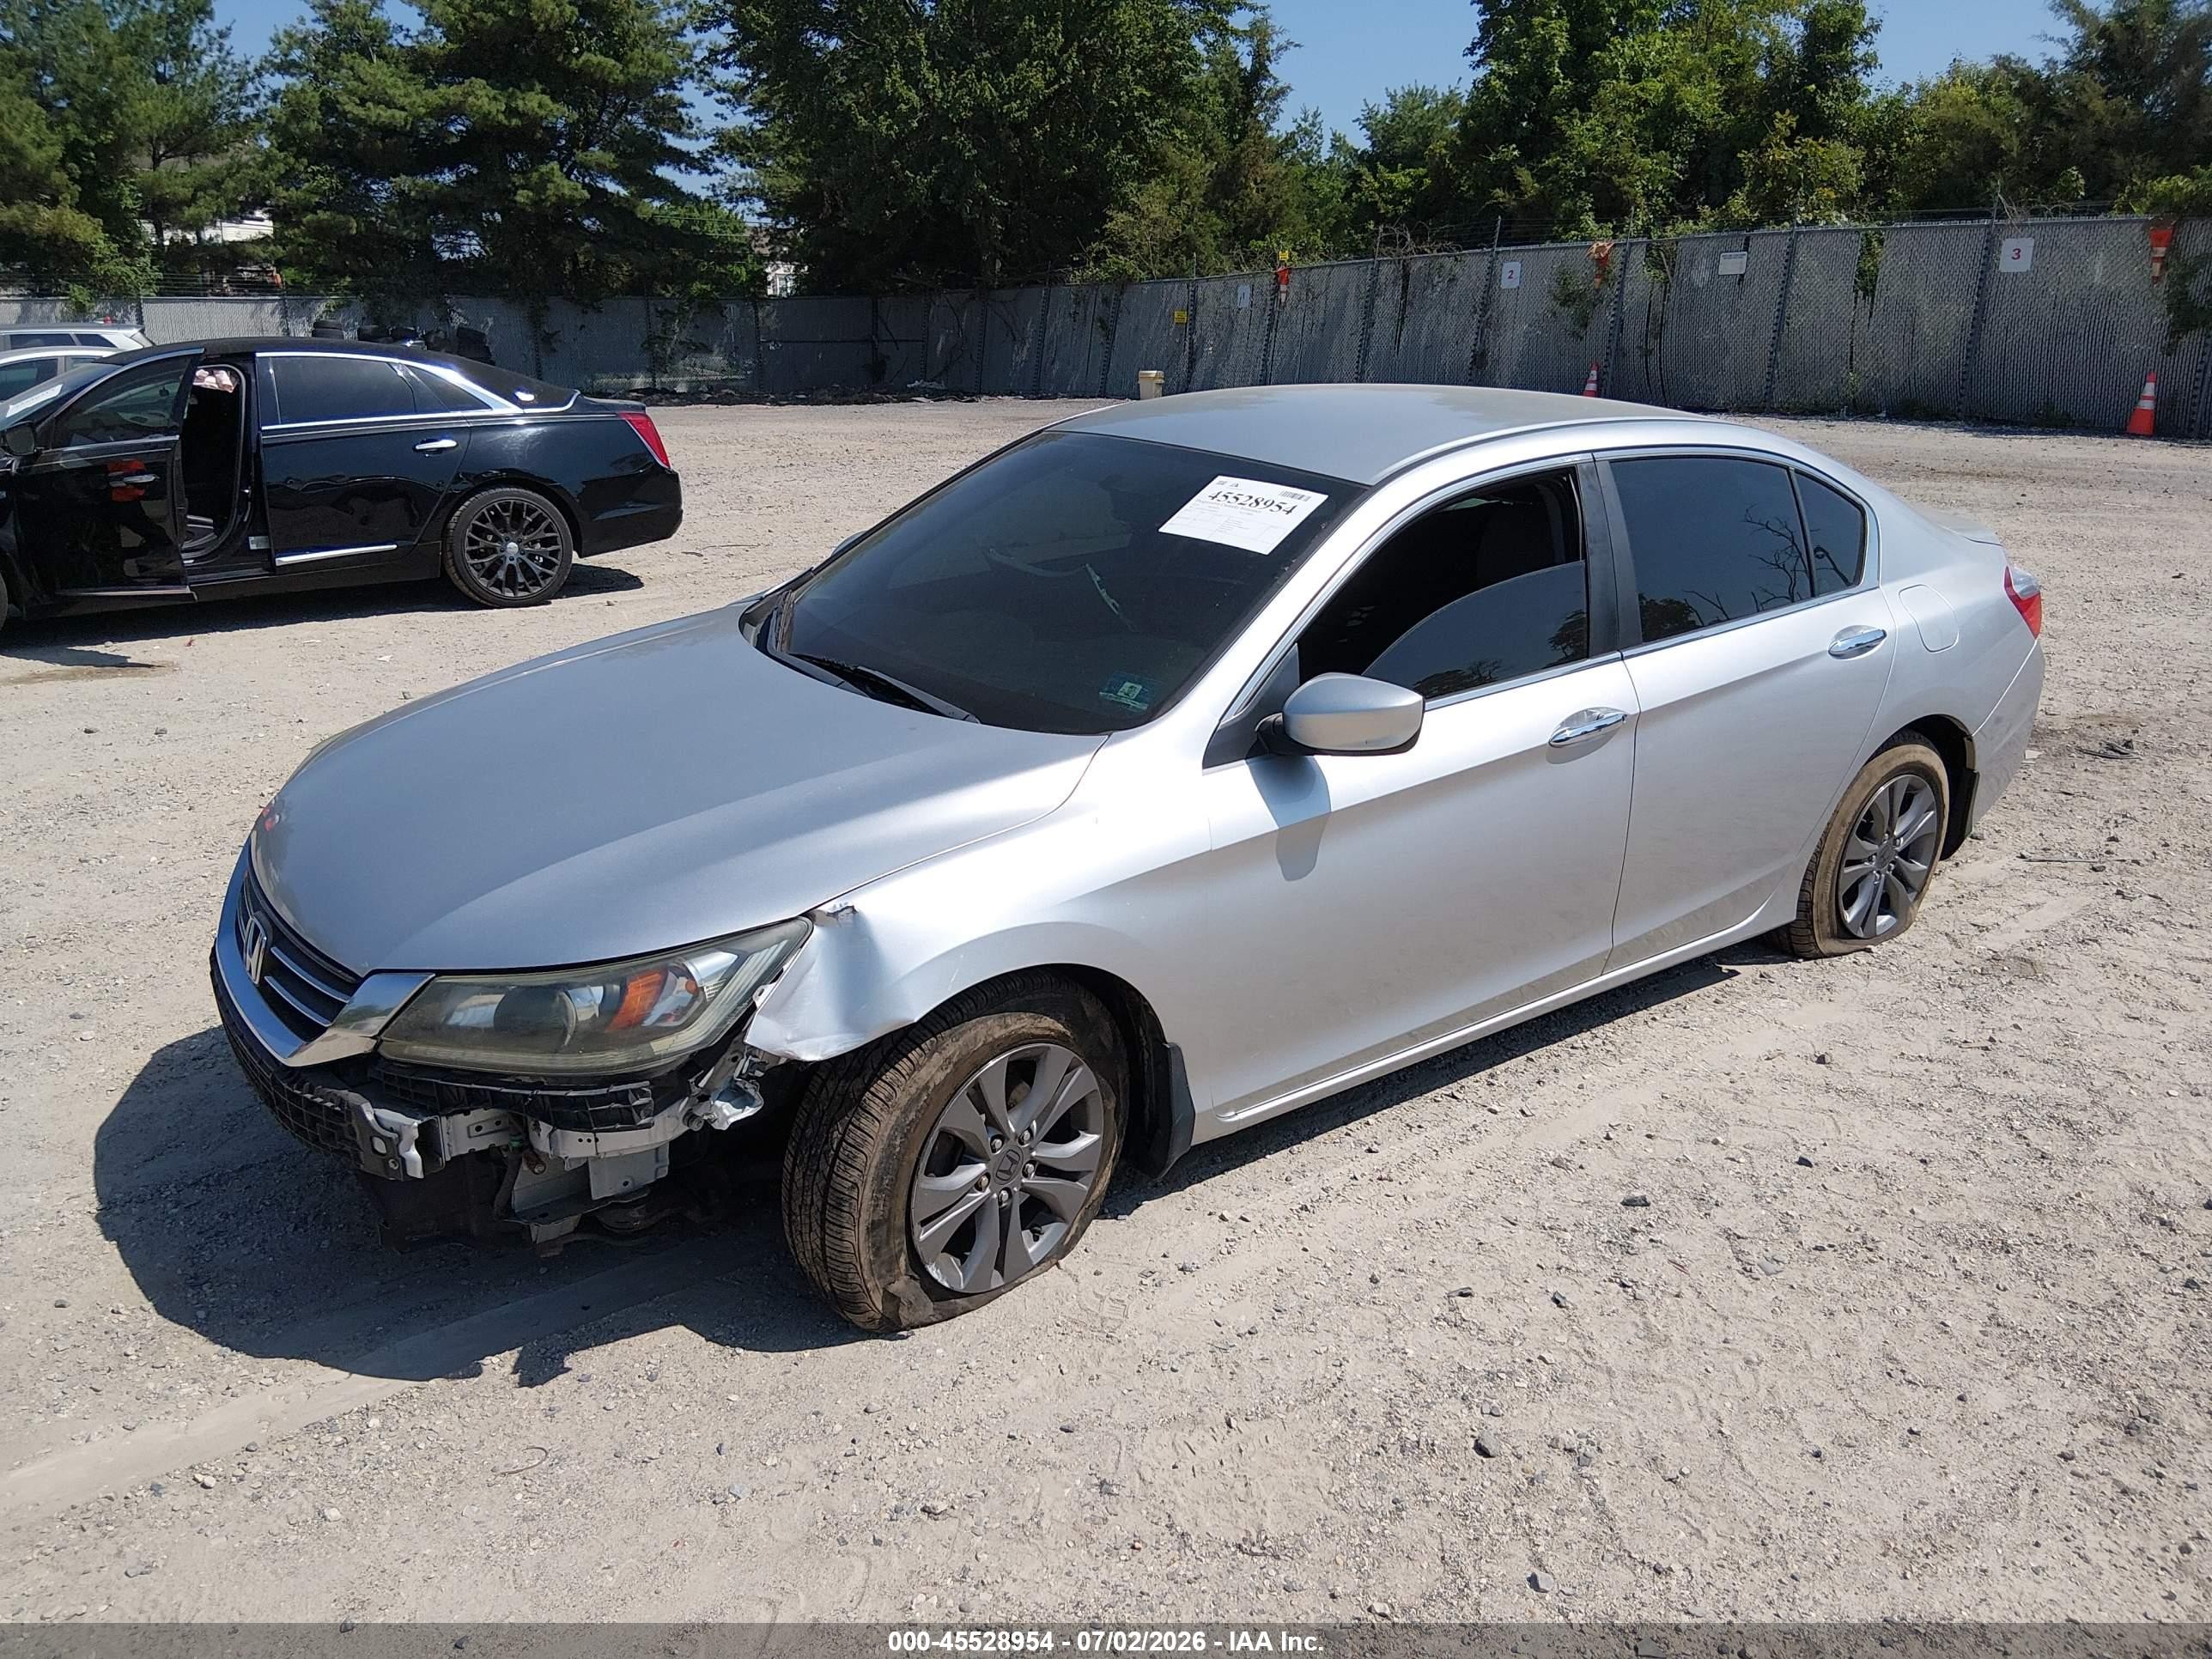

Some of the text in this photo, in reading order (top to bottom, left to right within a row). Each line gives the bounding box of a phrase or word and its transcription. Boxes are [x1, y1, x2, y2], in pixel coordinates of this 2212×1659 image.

[2011, 248, 2021, 260] 3
[1508, 270, 1514, 279] 2
[1208, 490, 1297, 515] 45528954
